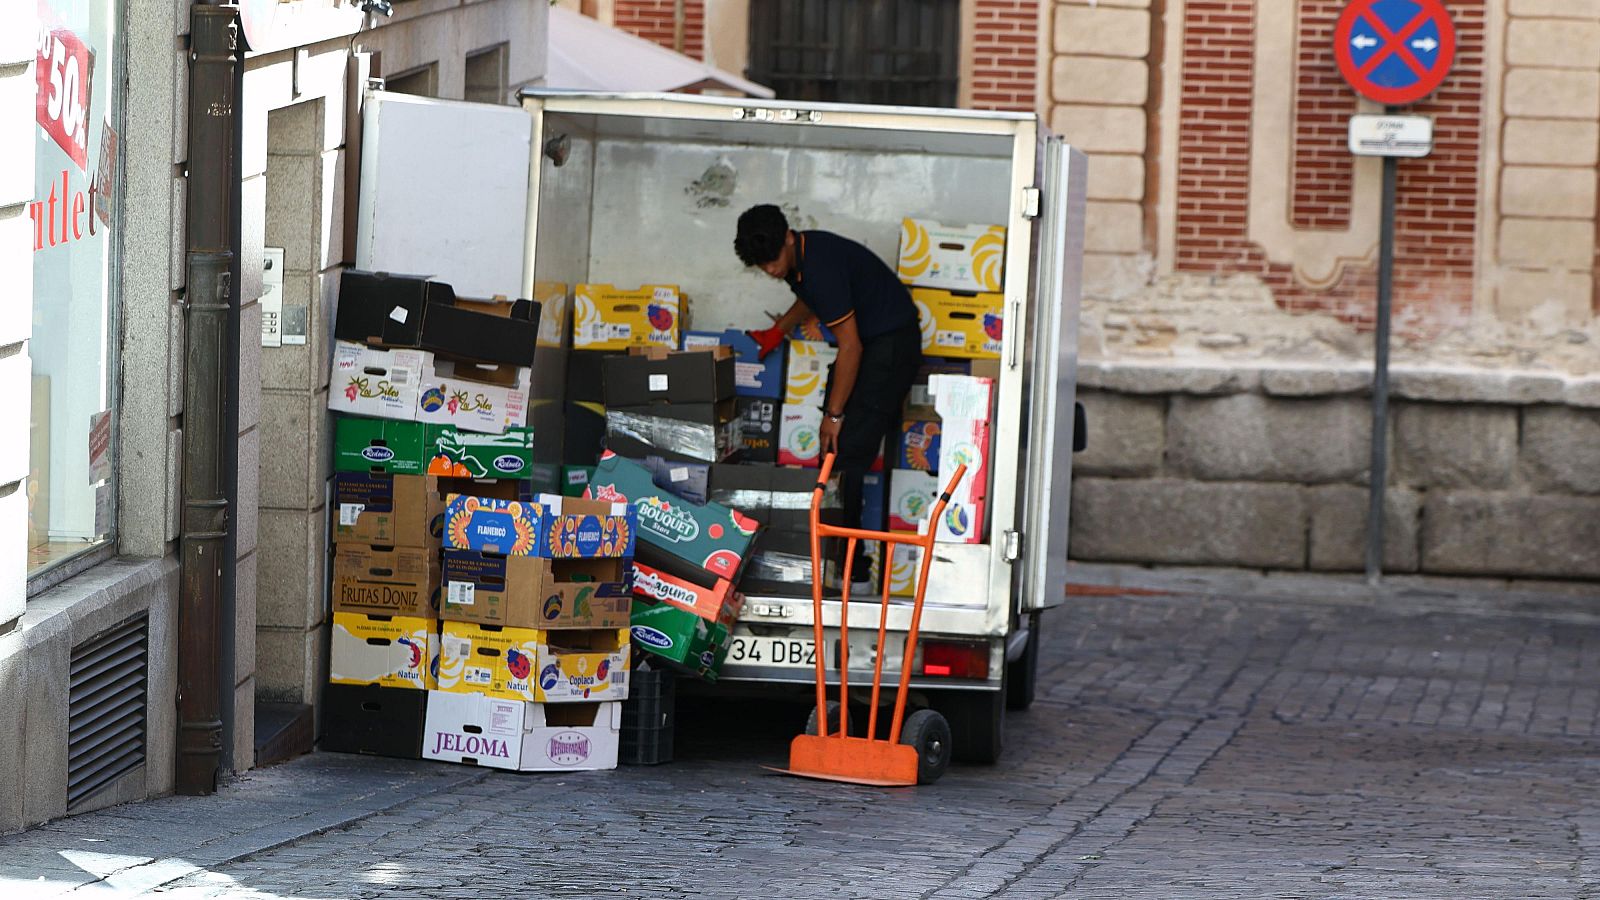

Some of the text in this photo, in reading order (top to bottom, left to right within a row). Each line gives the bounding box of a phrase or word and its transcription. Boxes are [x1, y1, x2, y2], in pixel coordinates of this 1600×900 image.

[640, 503, 693, 535] BOUQUET
[477, 525, 506, 537] FLAMENCO
[578, 531, 600, 542] FLAMENCO
[342, 584, 418, 607] FRUTAS DONIZ
[772, 641, 817, 665] DBZ
[397, 670, 419, 679] Natur
[569, 675, 594, 686] Coplaca
[507, 681, 529, 691] Natur
[432, 732, 510, 758] JELOMA
